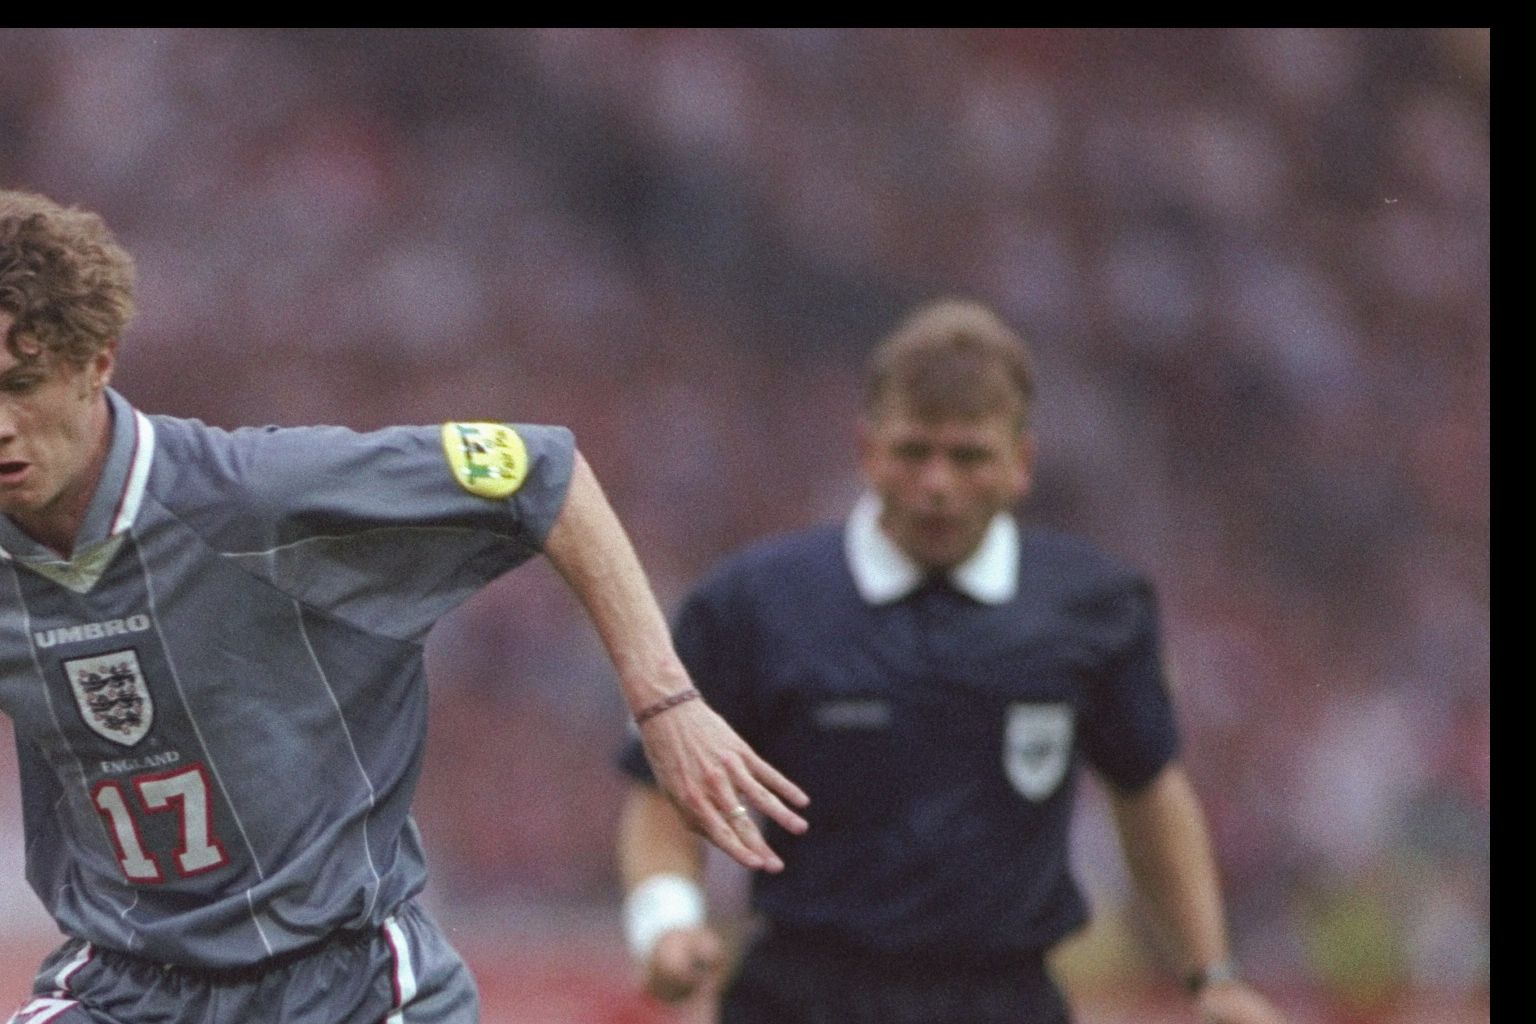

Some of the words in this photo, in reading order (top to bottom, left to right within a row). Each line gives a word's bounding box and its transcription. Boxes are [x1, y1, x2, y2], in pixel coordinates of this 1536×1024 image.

[33, 613, 150, 648] UMBRO
[100, 751, 180, 773] ENGLAND
[90, 760, 230, 885] 17
